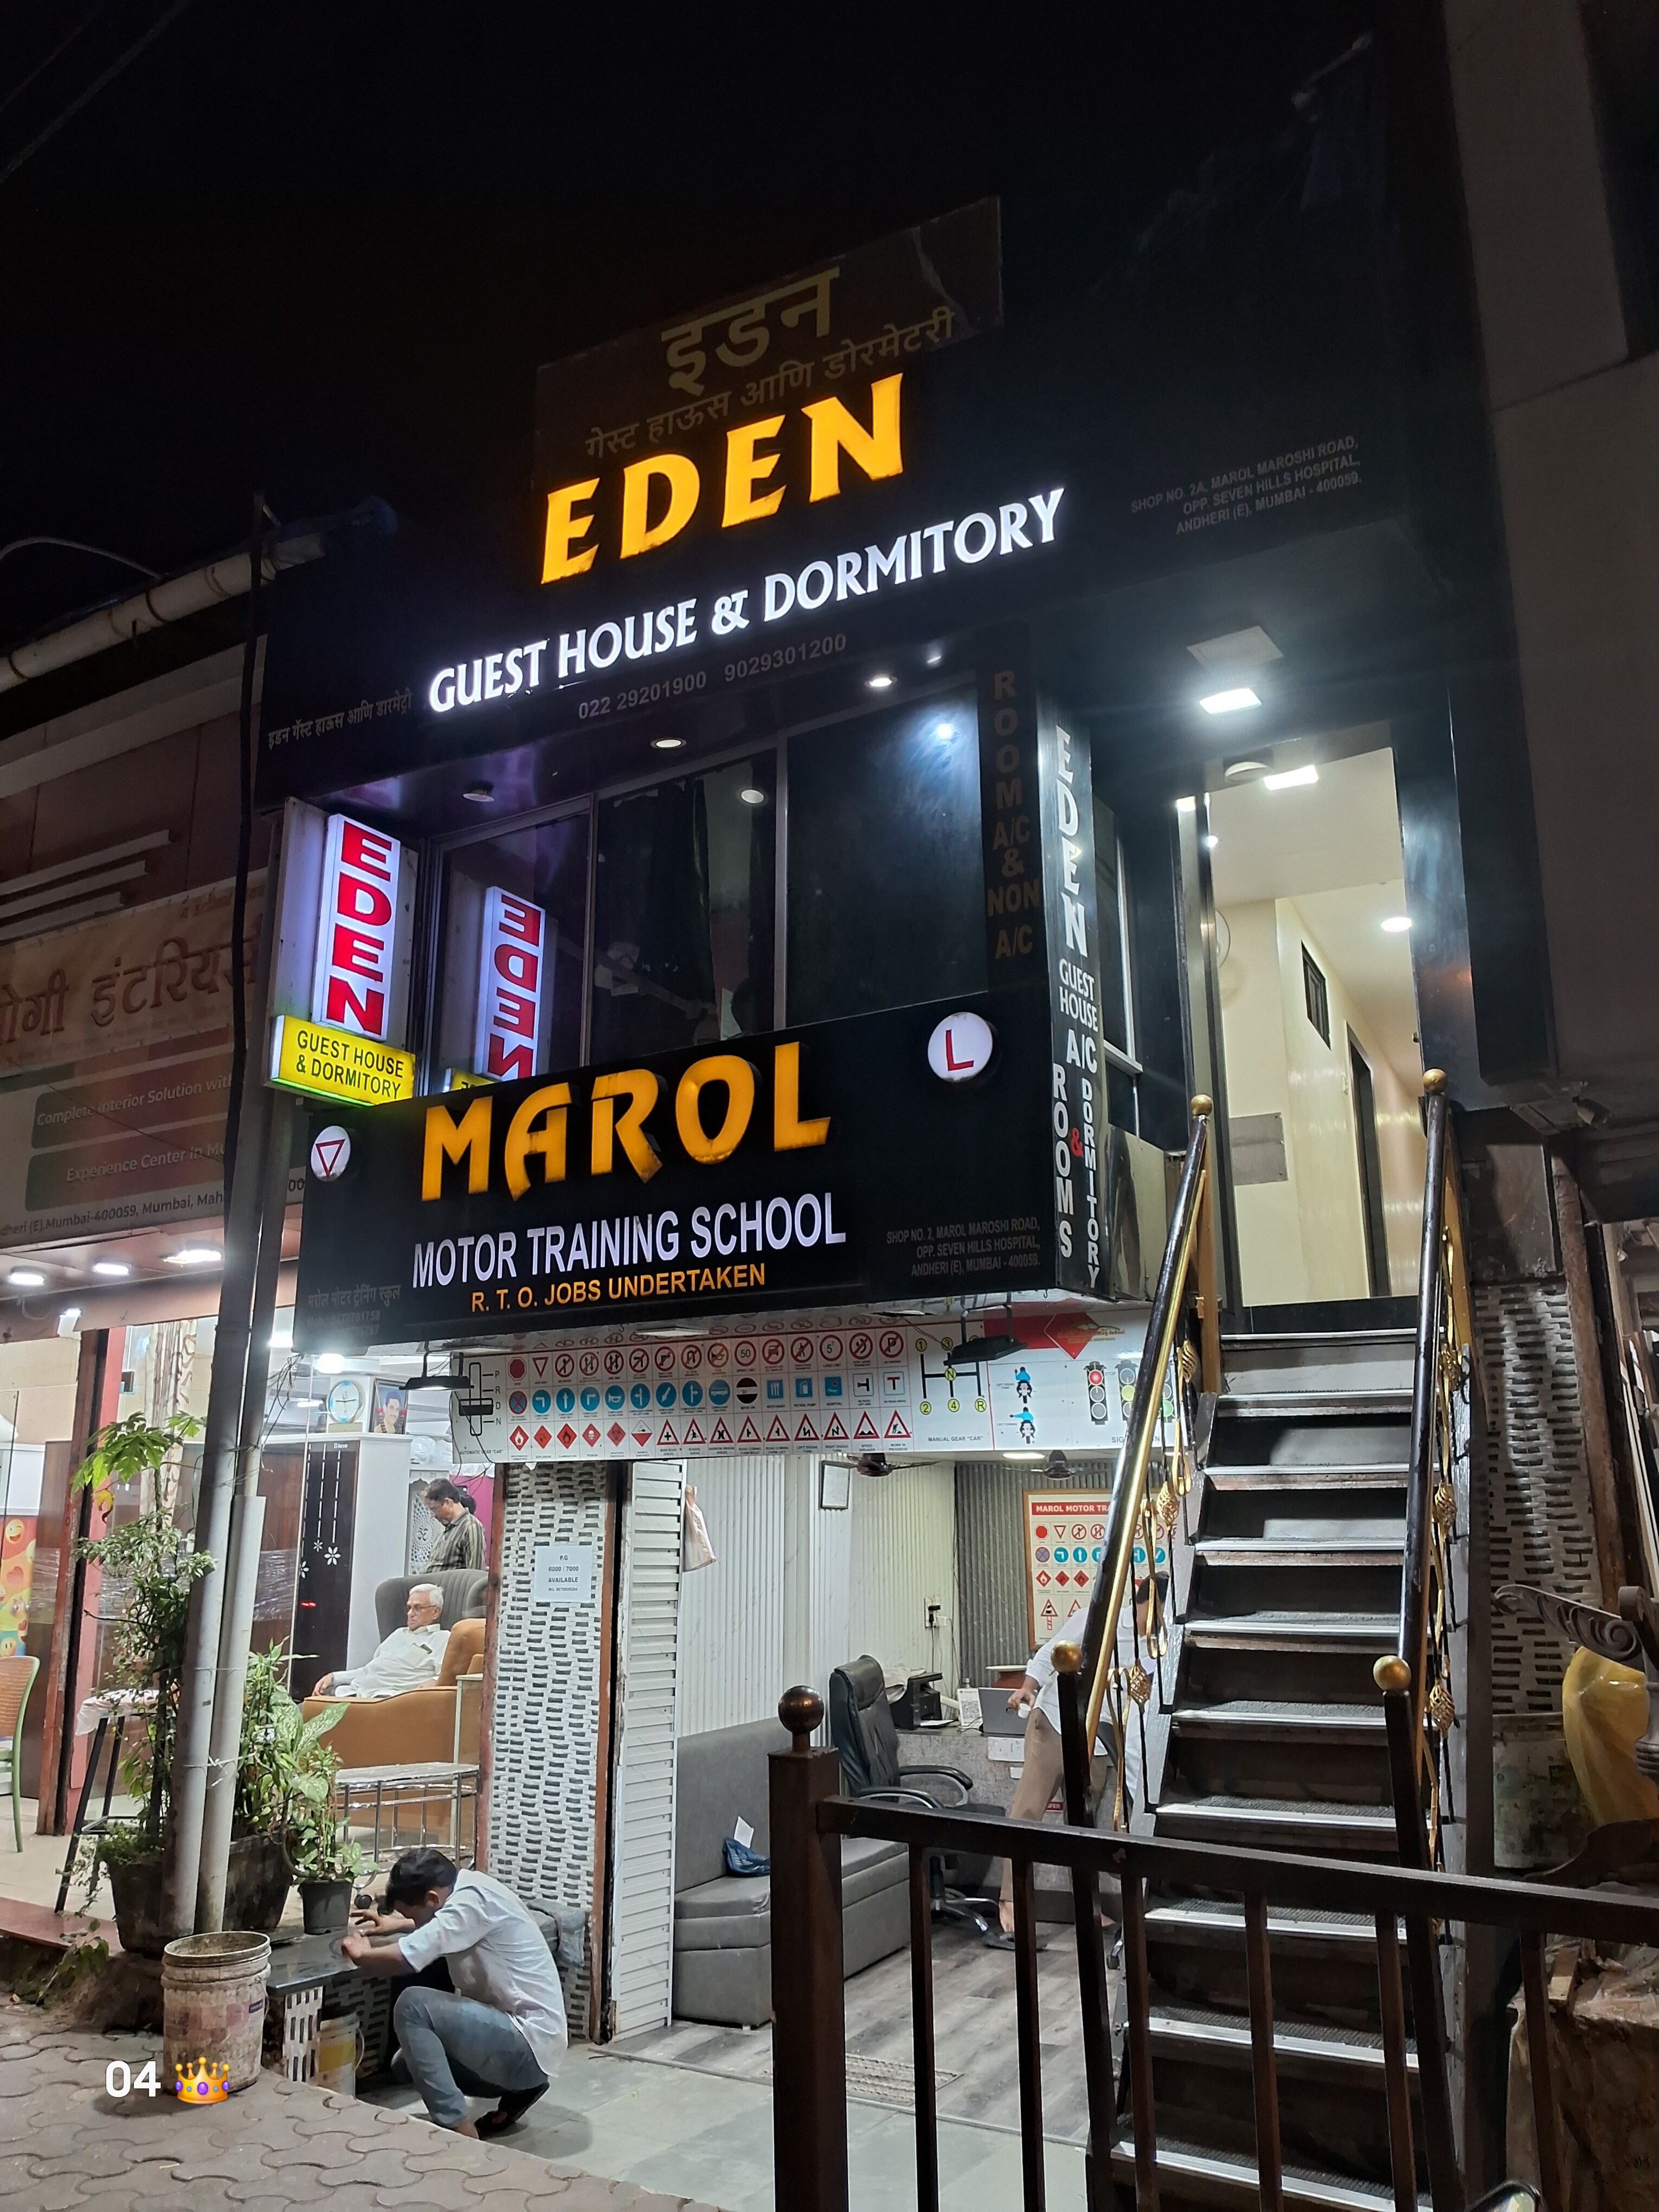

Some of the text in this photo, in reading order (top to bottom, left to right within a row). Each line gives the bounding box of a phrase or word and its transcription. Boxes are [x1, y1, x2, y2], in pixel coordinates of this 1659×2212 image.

[661, 266, 840, 397] इडन
[585, 306, 955, 460] गेस्ट हाऊस आणि डोरमेटरी
[541, 372, 903, 584] EDEN
[1130, 493, 1163, 513] SHOP
[1211, 467, 1255, 489] MAROL
[1257, 448, 1315, 476] MAROSHI
[1318, 435, 1358, 458] ROAD,
[1183, 454, 1360, 516] OPP. SEVEN HILLS HOSPITAL,
[1175, 507, 1230, 535] ANDHERI
[1233, 503, 1252, 520] (E),
[1256, 486, 1306, 512] MUMBAI
[1316, 471, 1362, 493] 400059.
[428, 488, 1066, 713] GUEST HOUSE & DORMITORY
[578, 633, 847, 720] 022 29201900 9029301200
[348, 699, 374, 724] आणि
[994, 670, 1023, 810] ROOM
[993, 815, 1031, 851] A/C
[1056, 724, 1089, 958] EDEN
[1001, 847, 1025, 877] &
[987, 878, 1040, 917] NON
[326, 820, 393, 1036] EDEN
[995, 924, 1033, 960] A/C
[1059, 957, 1095, 1002] GUEST
[1059, 986, 1099, 1033] HOUSE
[297, 1030, 404, 1078] GUEST HOUSE
[946, 1028, 975, 1071] L
[1066, 1028, 1098, 1074] A/C
[147, 1082, 202, 1104] Solution
[296, 1055, 401, 1101] & DORMITORY
[421, 1041, 832, 1202] MAROL
[1070, 1127, 1084, 1158] &
[67, 1158, 137, 1182] Experience
[141, 1149, 186, 1169] Center
[190, 1146, 203, 1159] in
[1053, 1063, 1075, 1258] ROOMS
[142, 1195, 193, 1215] Mumbai,
[1082, 1077, 1101, 1289] DORMITORY
[413, 1192, 847, 1289] MOTOR TRAINING SCHOOL
[886, 1217, 1040, 1244] SHOP NO. 2, MAROL MAROSHI ROAD,
[916, 1235, 1040, 1259] OPP. SEVEN HILLS HOSPITAL,
[911, 1261, 948, 1276] ANDHERI
[950, 1260, 964, 1275] (E),
[966, 1256, 1001, 1272] MUMBAI
[1008, 1253, 1040, 1268] 400059.
[471, 1263, 766, 1313] R. T. O. JOBS UNDERTAKEN
[494, 1370, 500, 1379] P
[741, 1349, 751, 1358] 50
[495, 1386, 500, 1394] R
[496, 1401, 501, 1410] D
[923, 1404, 928, 1413] 2
[951, 1401, 956, 1410] 4
[978, 1400, 985, 1410] R
[496, 1417, 501, 1425] N
